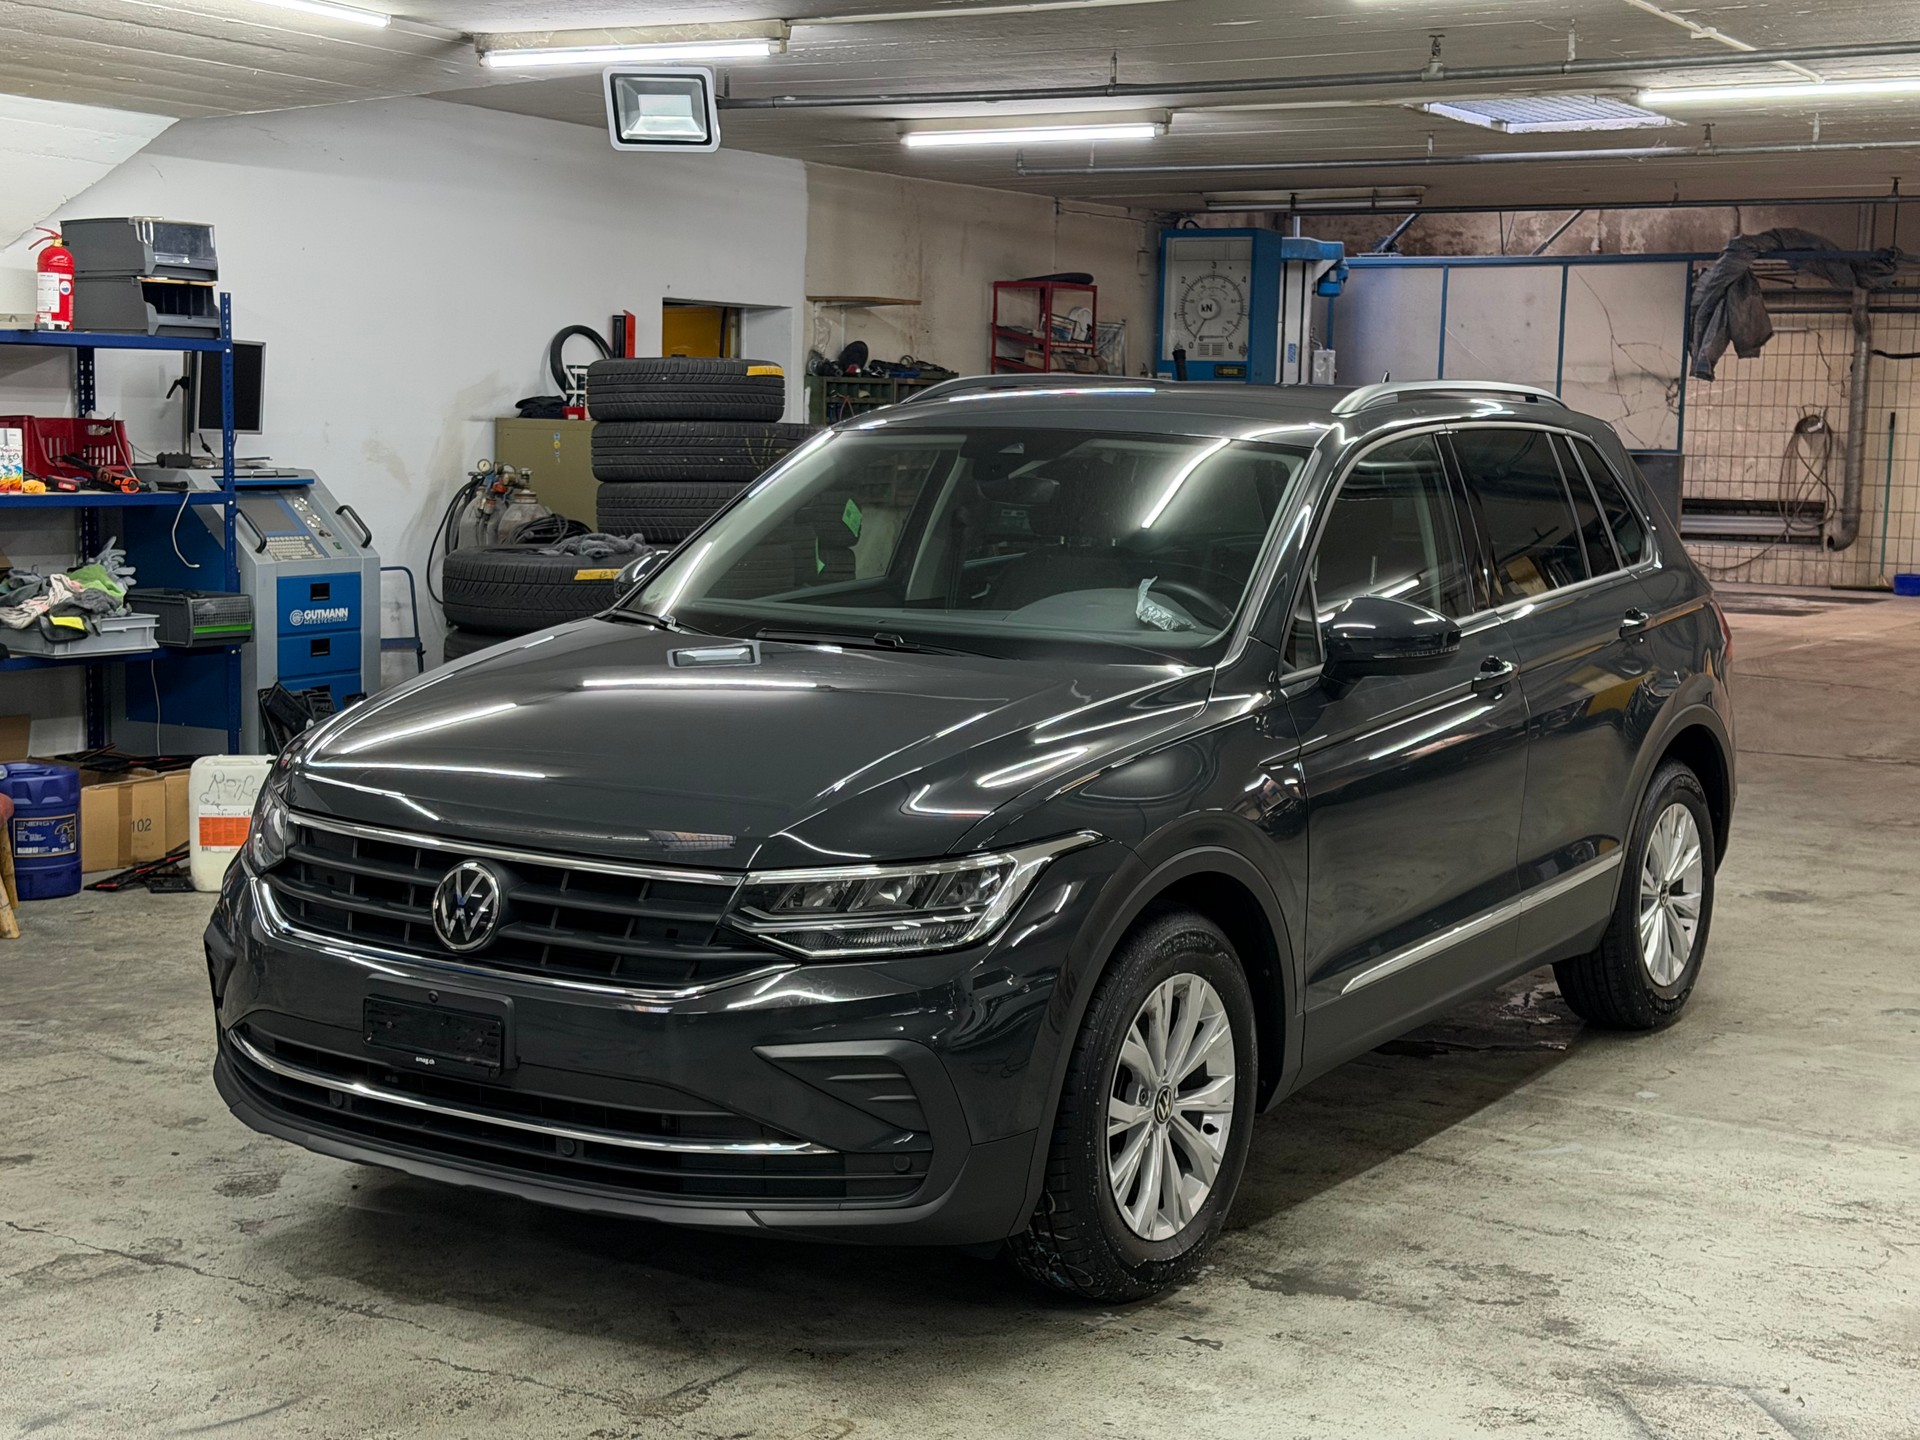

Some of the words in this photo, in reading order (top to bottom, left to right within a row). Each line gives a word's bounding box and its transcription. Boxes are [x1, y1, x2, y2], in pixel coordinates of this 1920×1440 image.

[1211, 261, 1217, 269] 3
[1201, 304, 1213, 312] kN
[304, 607, 349, 619] GUTMANN
[131, 818, 152, 832] 102
